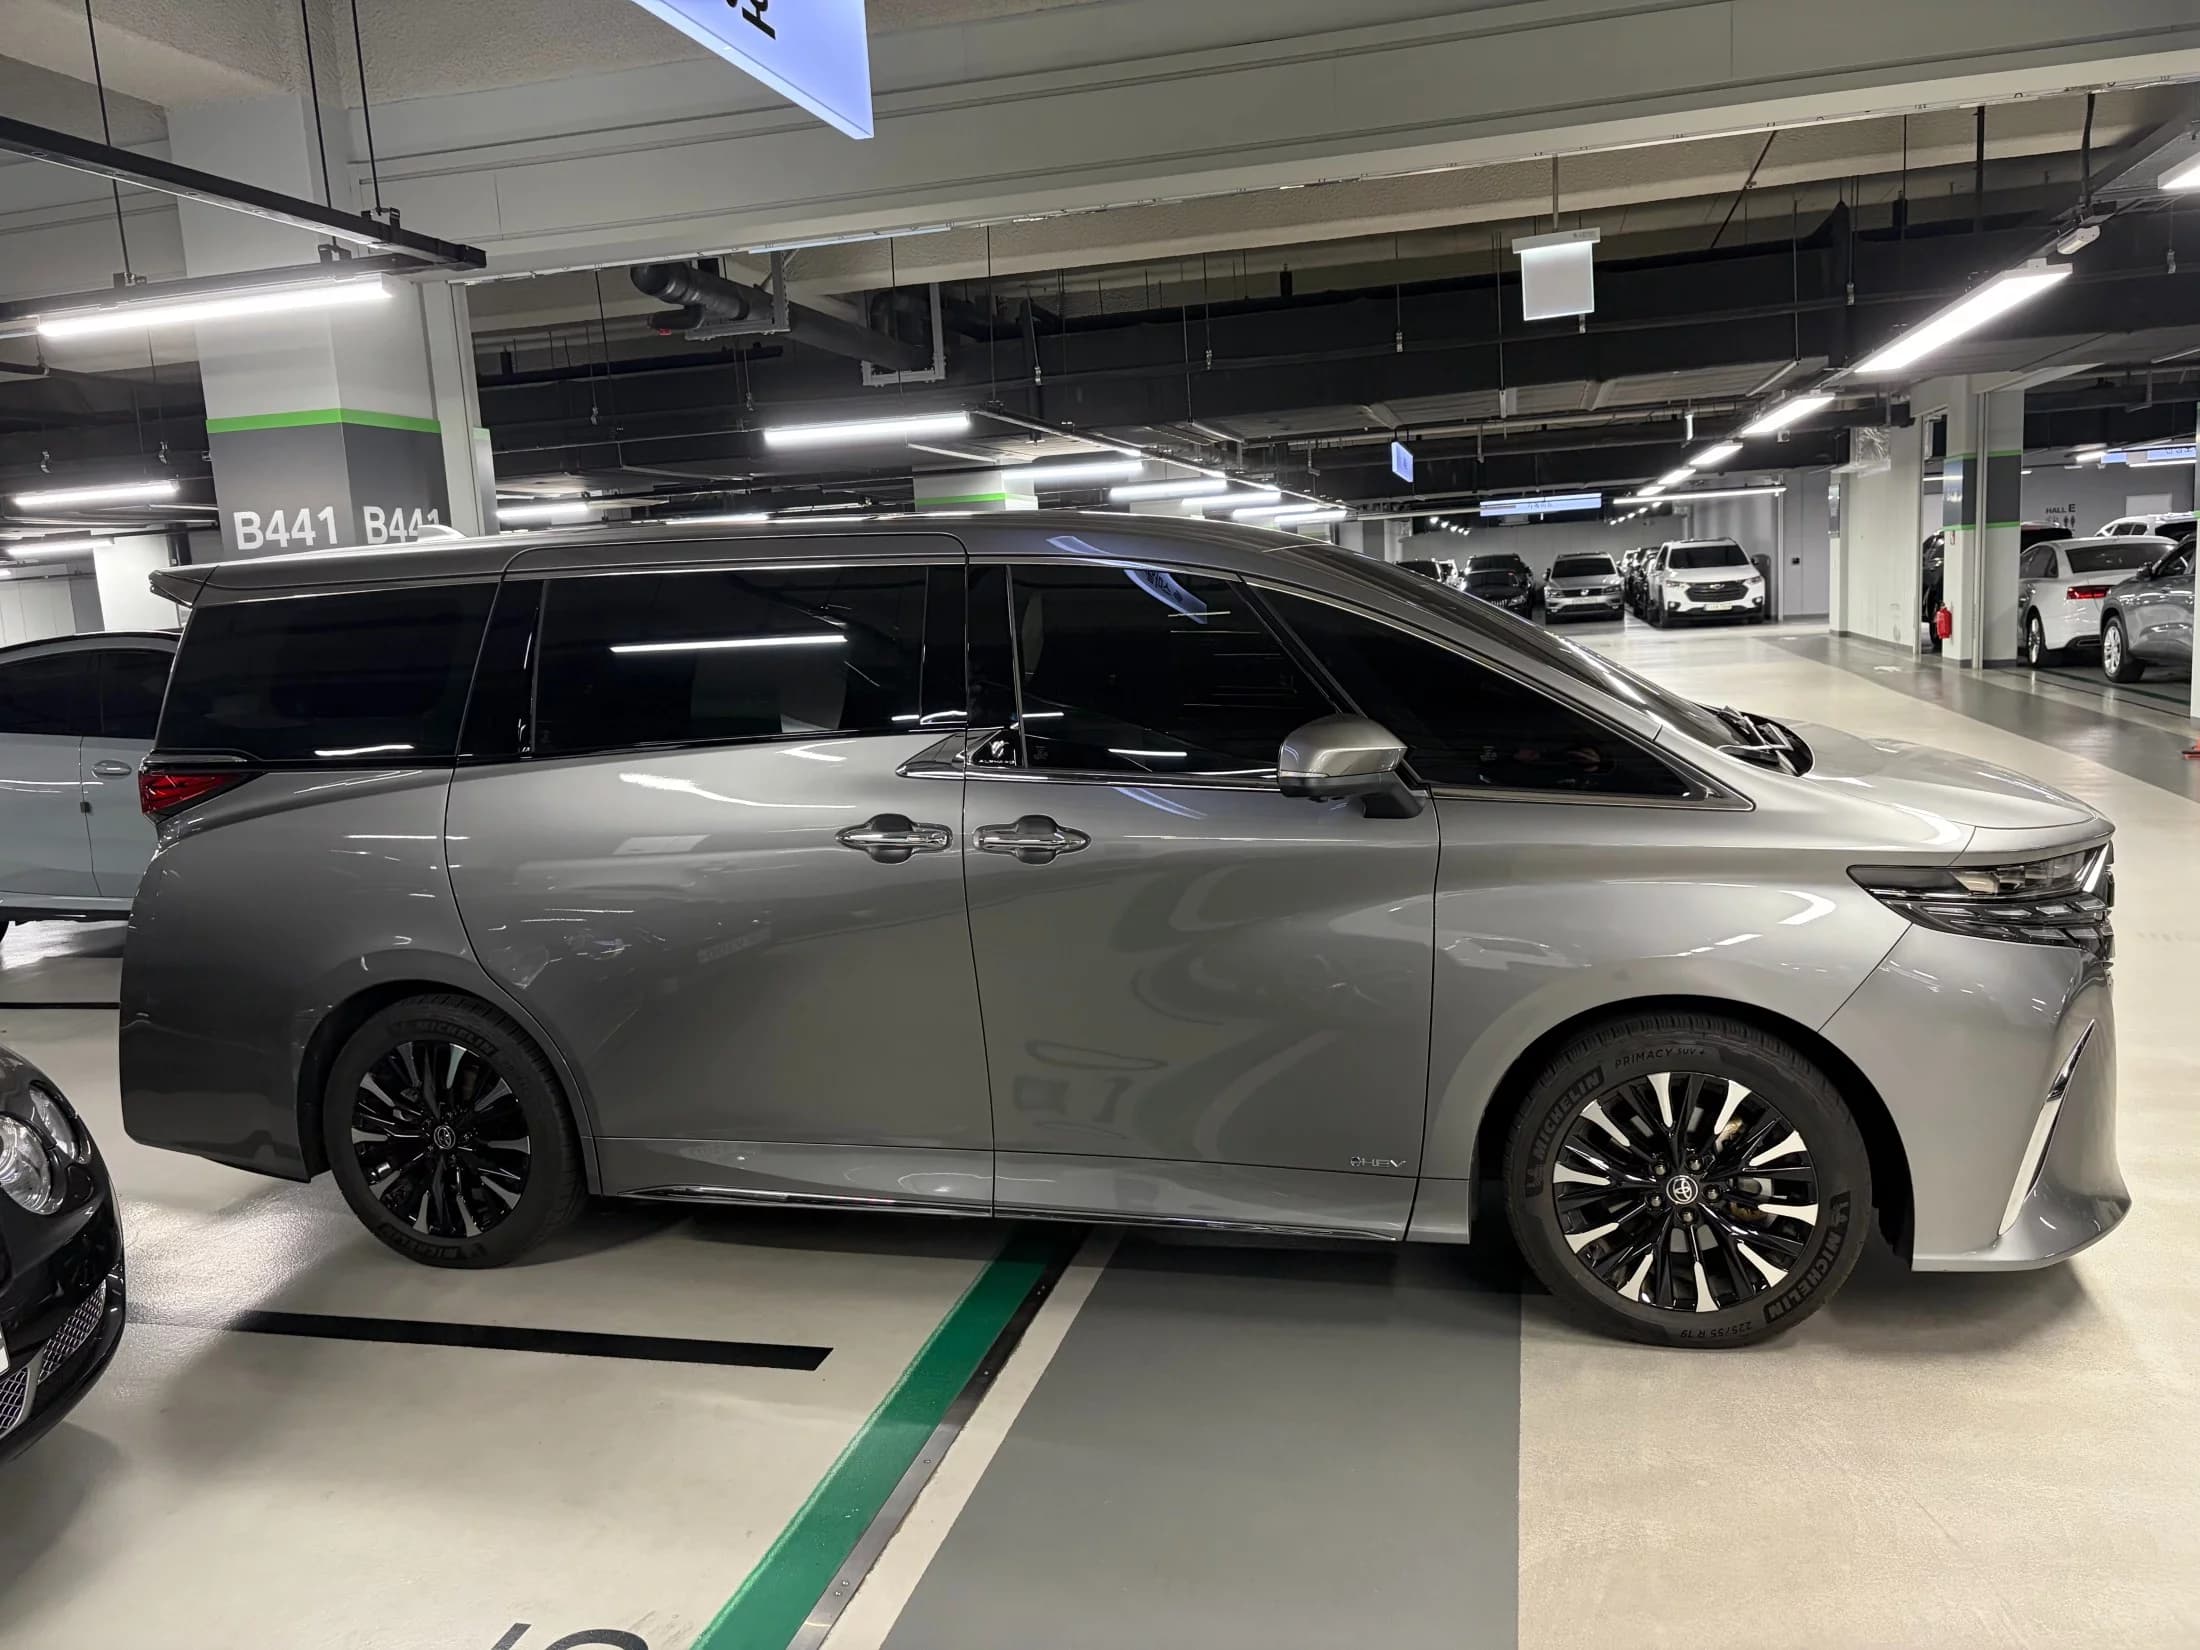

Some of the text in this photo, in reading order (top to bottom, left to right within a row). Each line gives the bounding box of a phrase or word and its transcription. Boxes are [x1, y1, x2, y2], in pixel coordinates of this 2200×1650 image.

[233, 506, 338, 550] B441
[2068, 503, 2076, 513] E
[1615, 1047, 1673, 1069] PRIMACY
[1678, 1047, 1697, 1056] SUV
[1532, 1069, 1601, 1161] MICHELIN
[1767, 1230, 1843, 1320] MICHELIN
